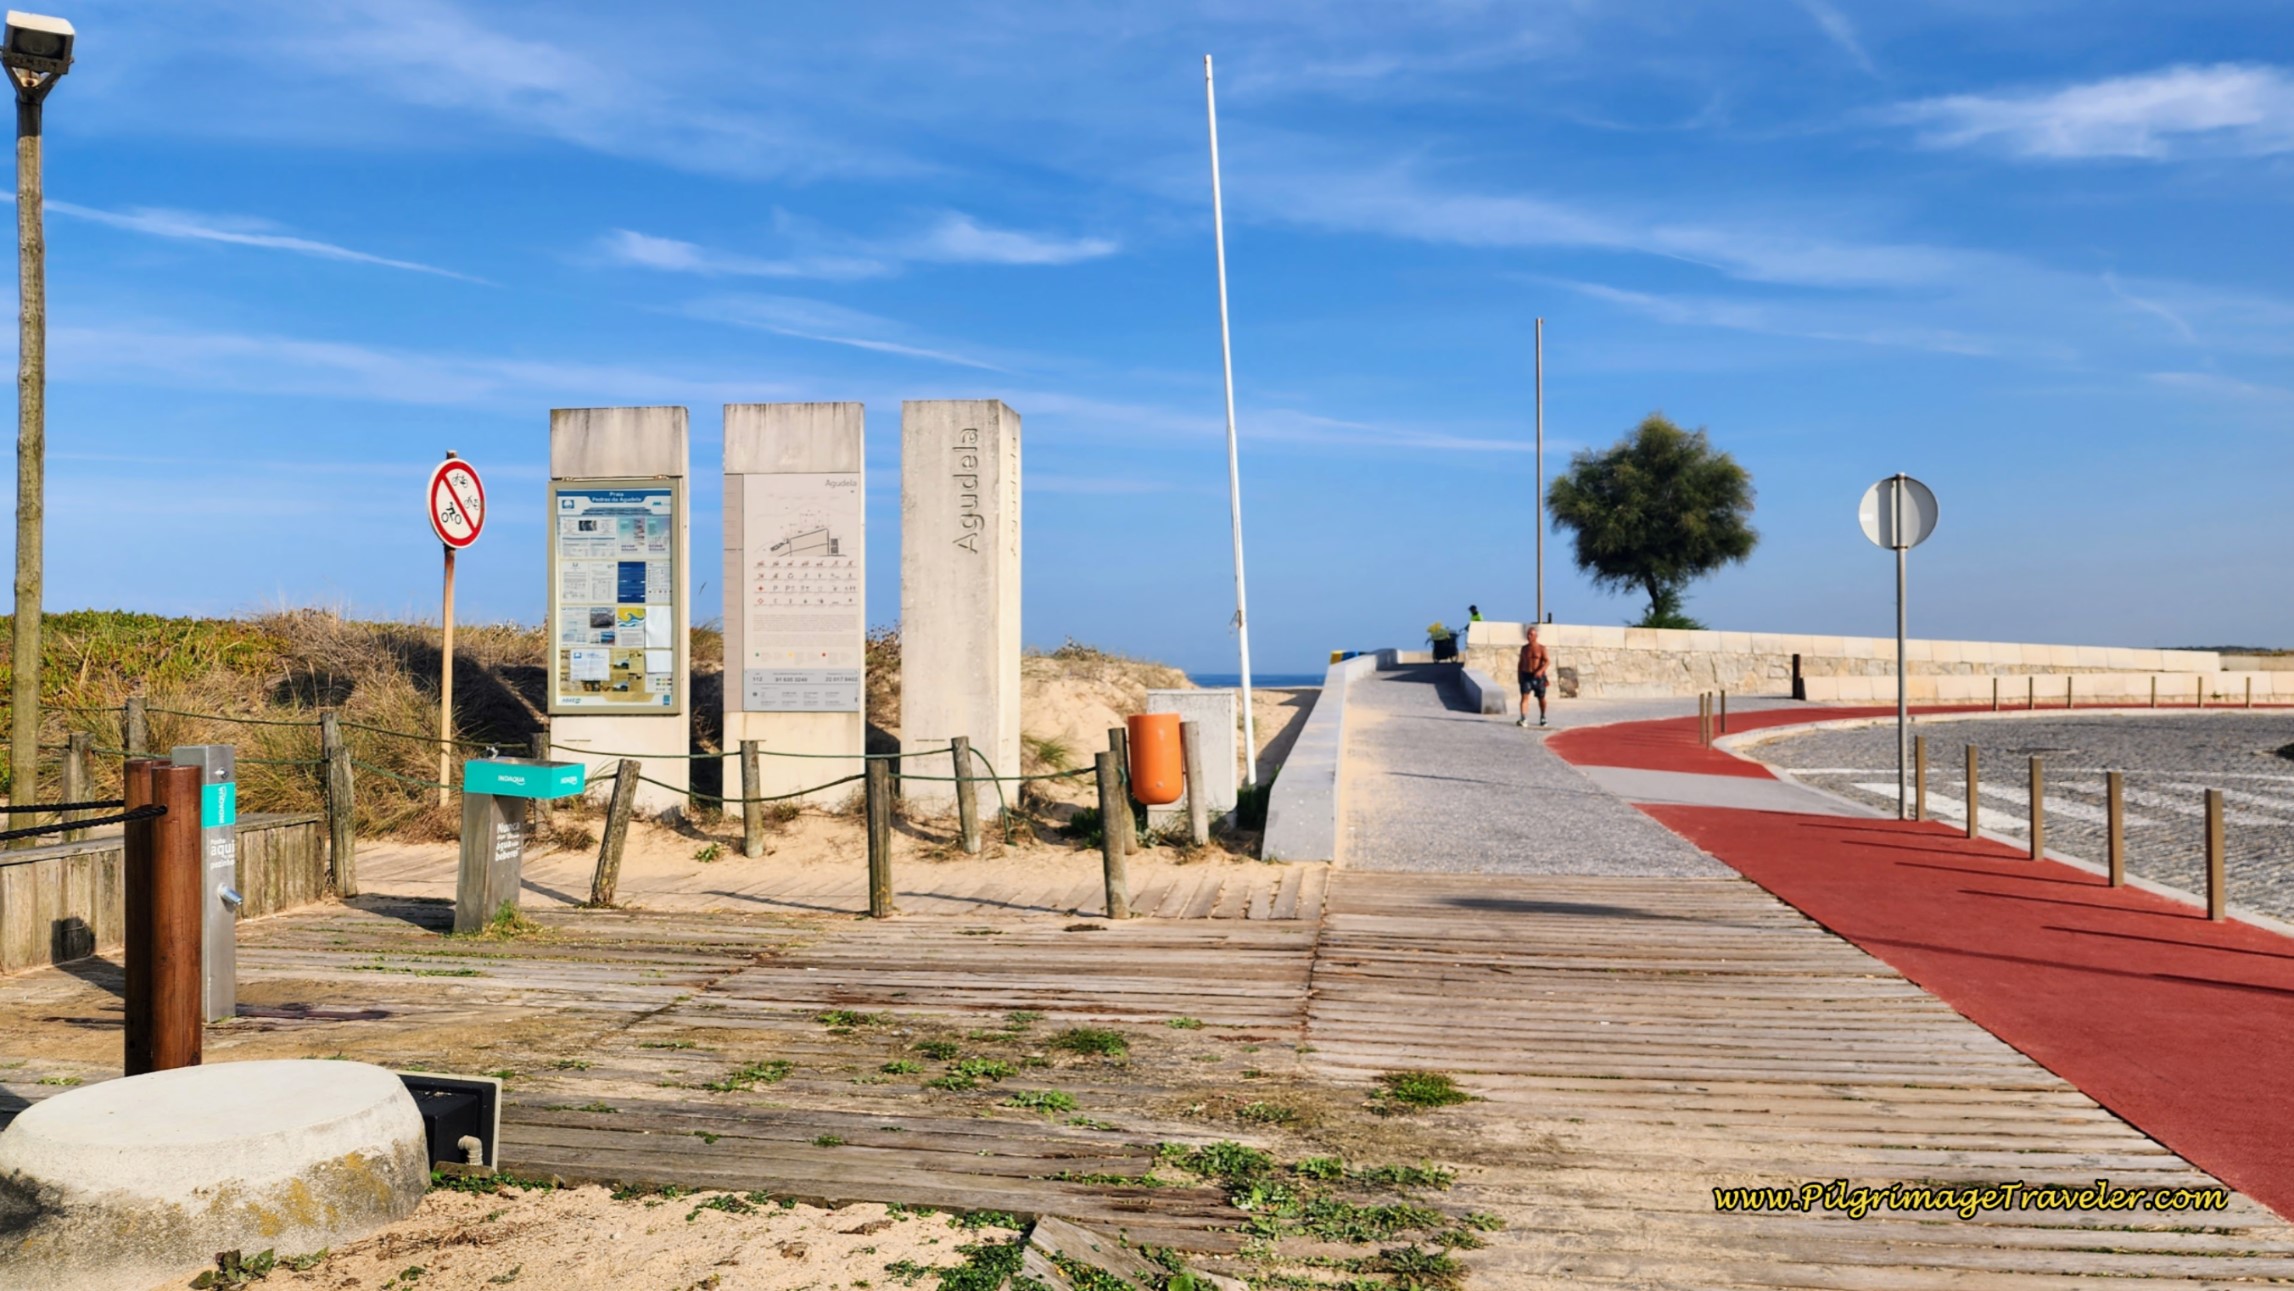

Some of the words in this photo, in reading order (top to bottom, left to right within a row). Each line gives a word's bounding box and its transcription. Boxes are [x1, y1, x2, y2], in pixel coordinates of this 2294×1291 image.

[824, 479, 857, 489] Agudela
[952, 427, 985, 554] Agudela
[497, 775, 526, 786] INDAQUA
[497, 821, 520, 834] Nunca
[210, 839, 235, 859] aqui
